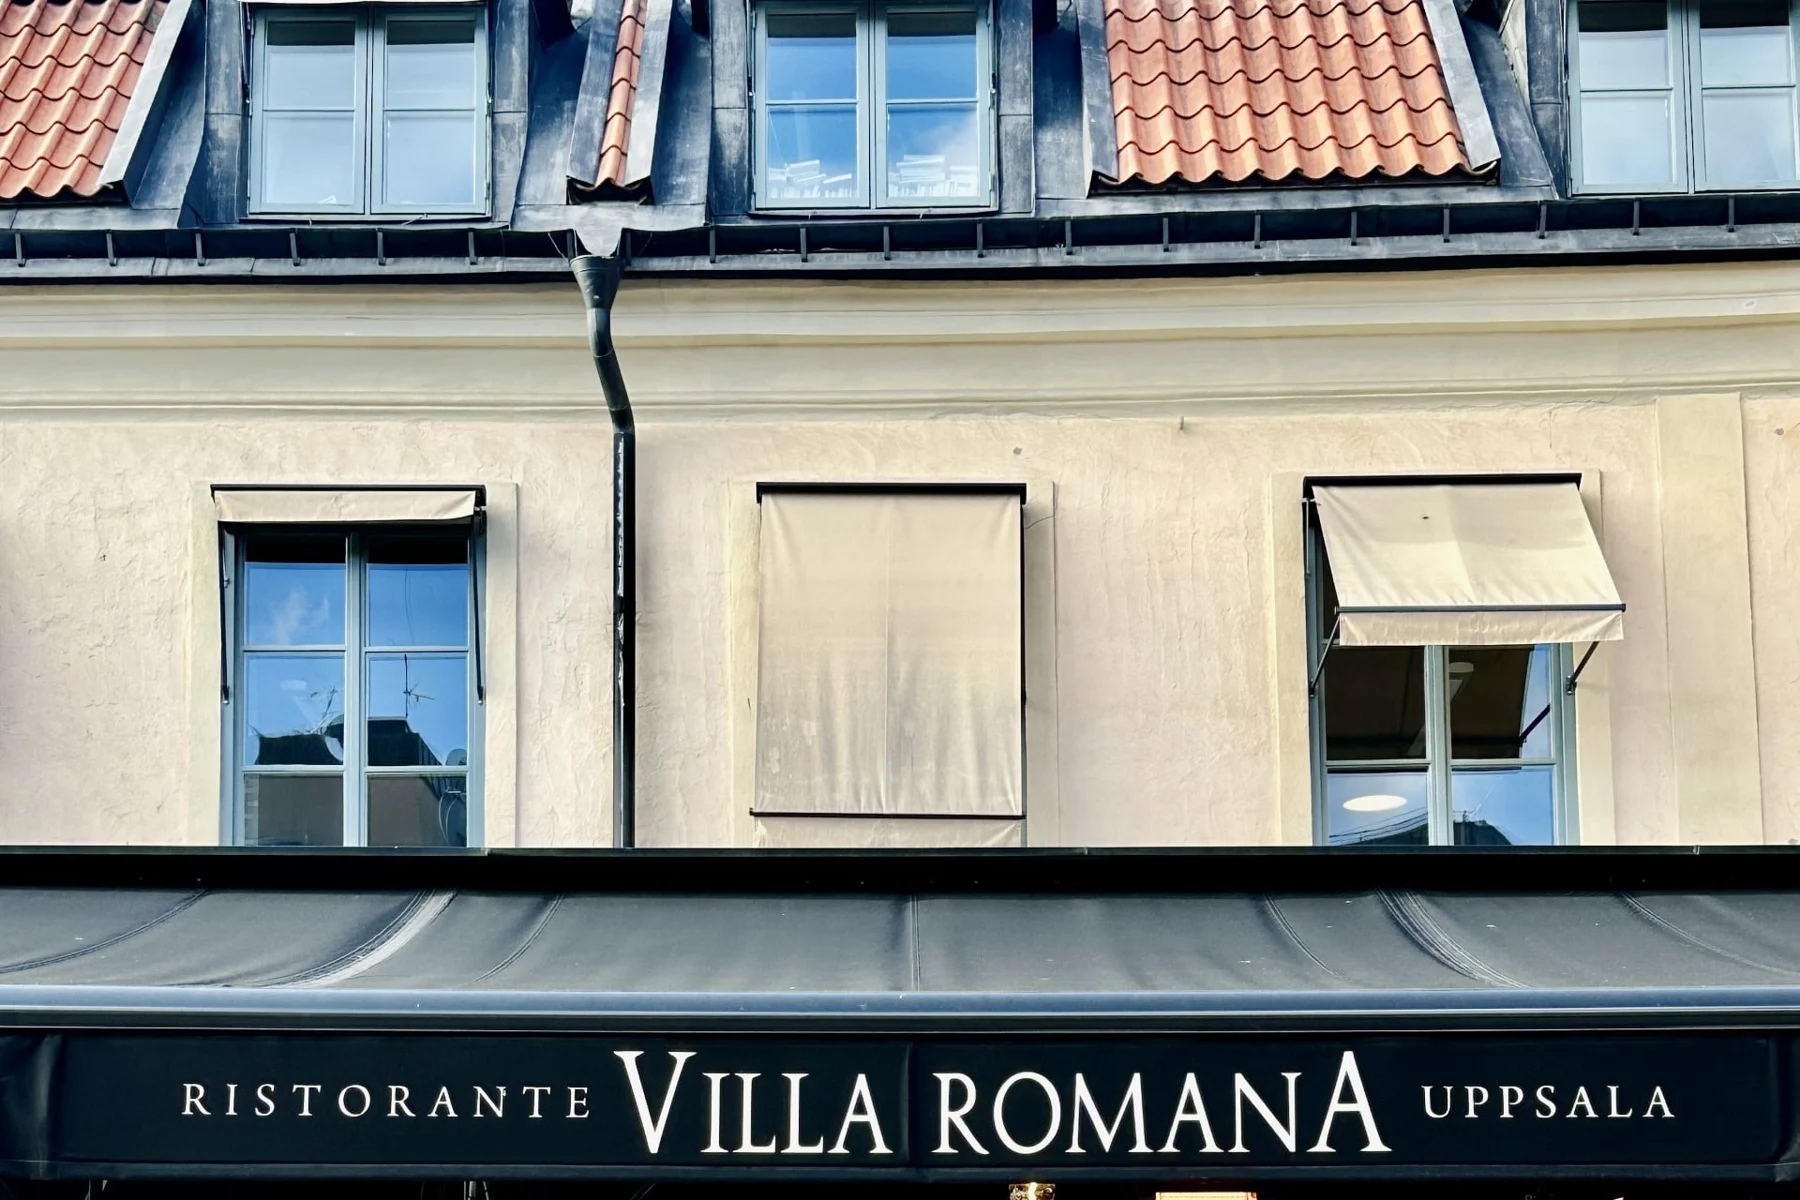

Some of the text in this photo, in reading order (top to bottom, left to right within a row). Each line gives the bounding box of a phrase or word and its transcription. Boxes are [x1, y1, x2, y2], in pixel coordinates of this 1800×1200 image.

[181, 1050, 1675, 1155] RISTORANTE VILLA ROMANA UPPSALA
